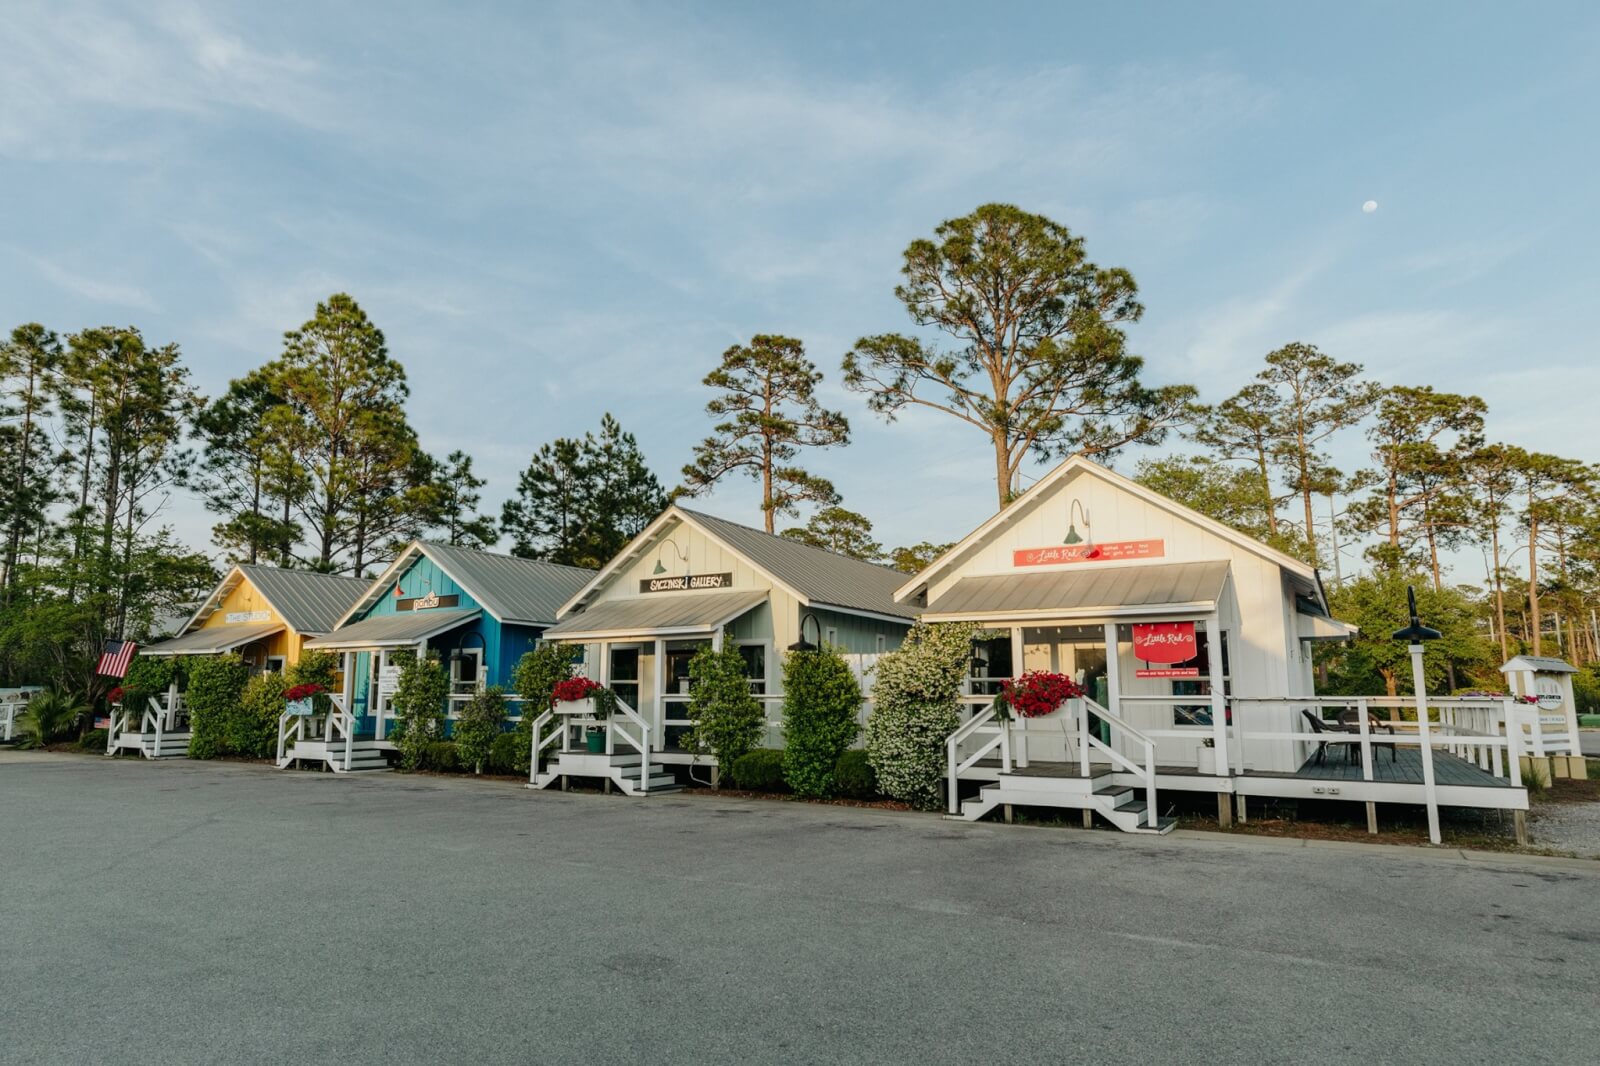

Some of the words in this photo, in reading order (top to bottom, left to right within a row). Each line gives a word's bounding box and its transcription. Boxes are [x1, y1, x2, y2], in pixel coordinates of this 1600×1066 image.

[1036, 550, 1060, 563] Little
[1061, 549, 1078, 560] Red
[690, 576, 722, 588] GALLERY
[1143, 633, 1167, 647] Little
[1167, 632, 1182, 645] Red
